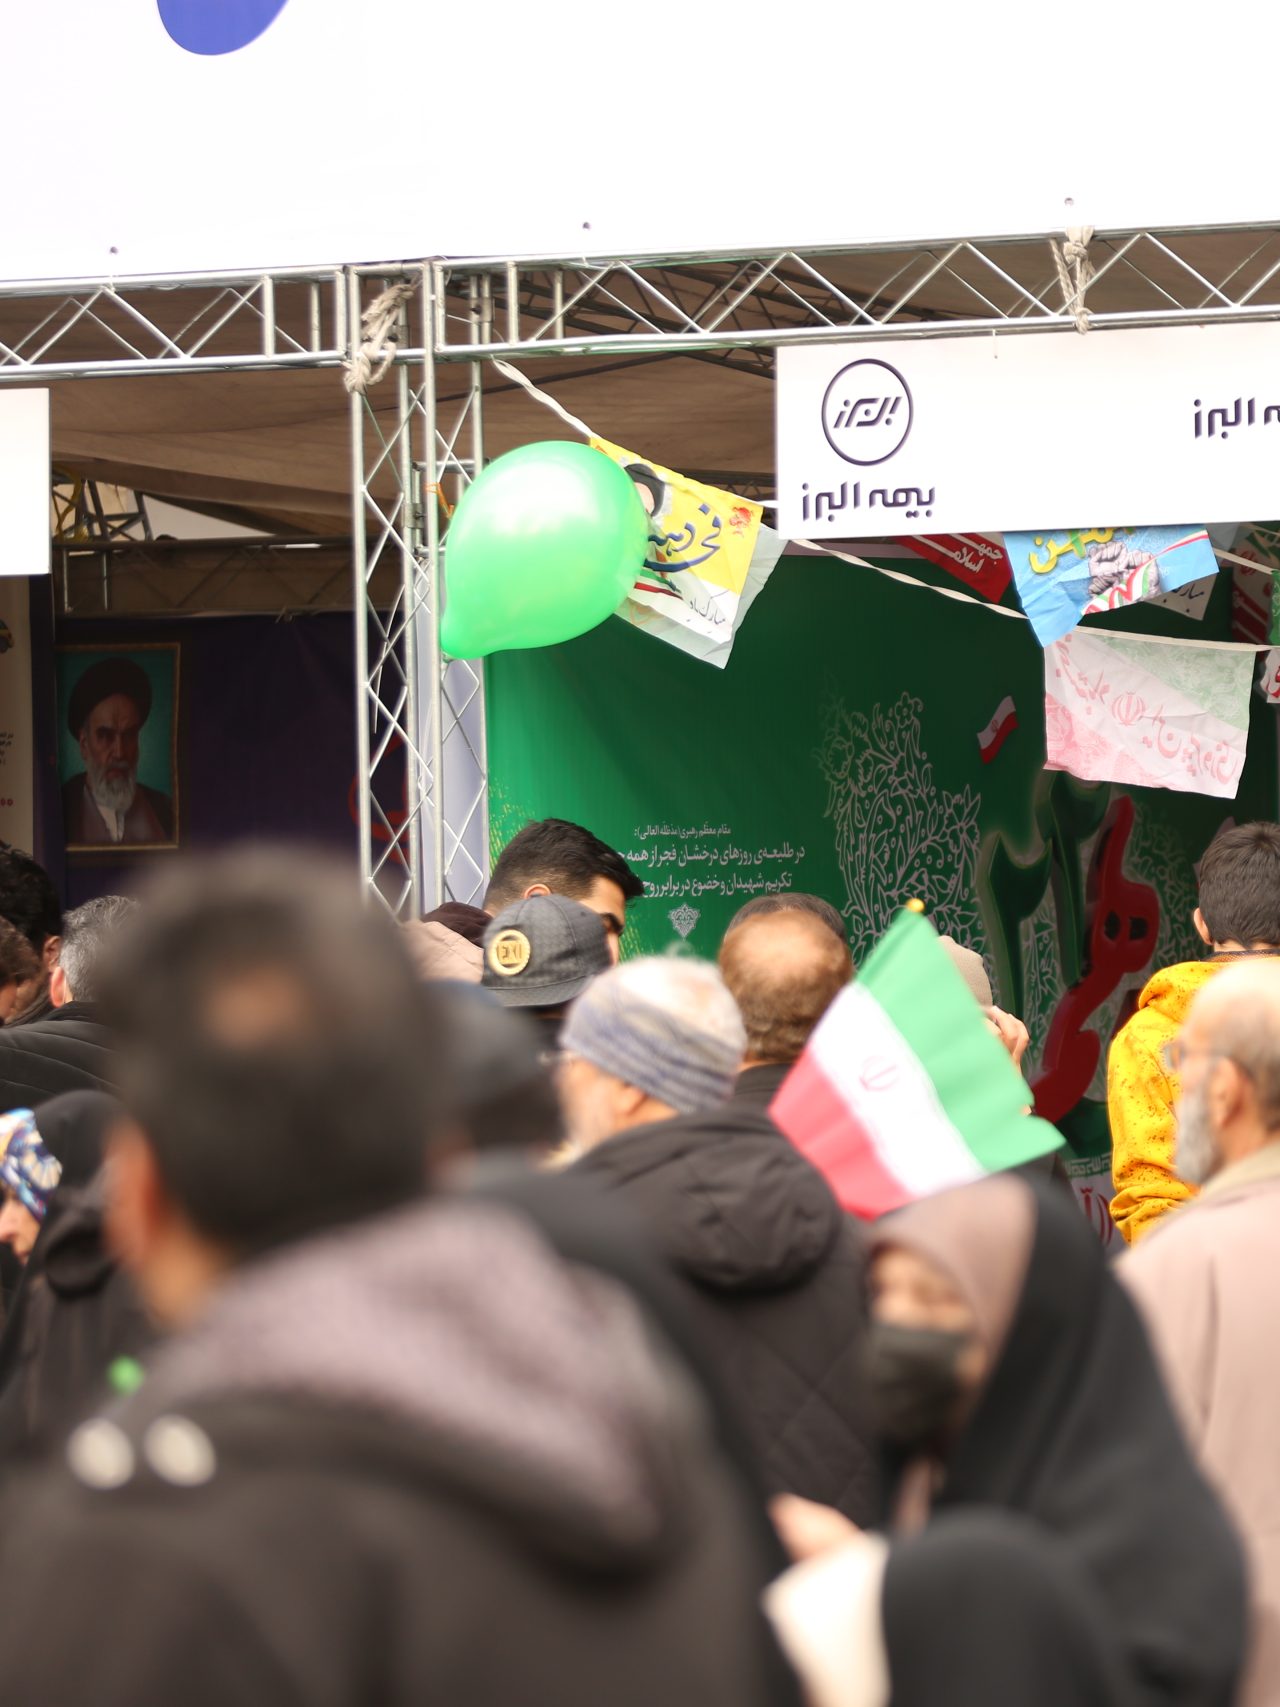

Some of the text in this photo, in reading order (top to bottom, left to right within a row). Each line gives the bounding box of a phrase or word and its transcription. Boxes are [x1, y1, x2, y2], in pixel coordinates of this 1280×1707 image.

[1193, 396, 1256, 440] البرز
[801, 480, 936, 523] بیمه البرز
[912, 535, 985, 574] اسلام
[948, 533, 1003, 566] جمه
[626, 849, 649, 862] همه
[647, 844, 658, 868] از
[656, 844, 677, 868] فجر
[678, 844, 720, 867] درخشان
[719, 843, 753, 866] روزهای
[794, 845, 806, 864] در
[679, 878, 691, 897] در
[691, 873, 720, 897] خضوع
[719, 878, 727, 896] و
[726, 872, 766, 896] شهیدان
[764, 871, 793, 894] تکریم
